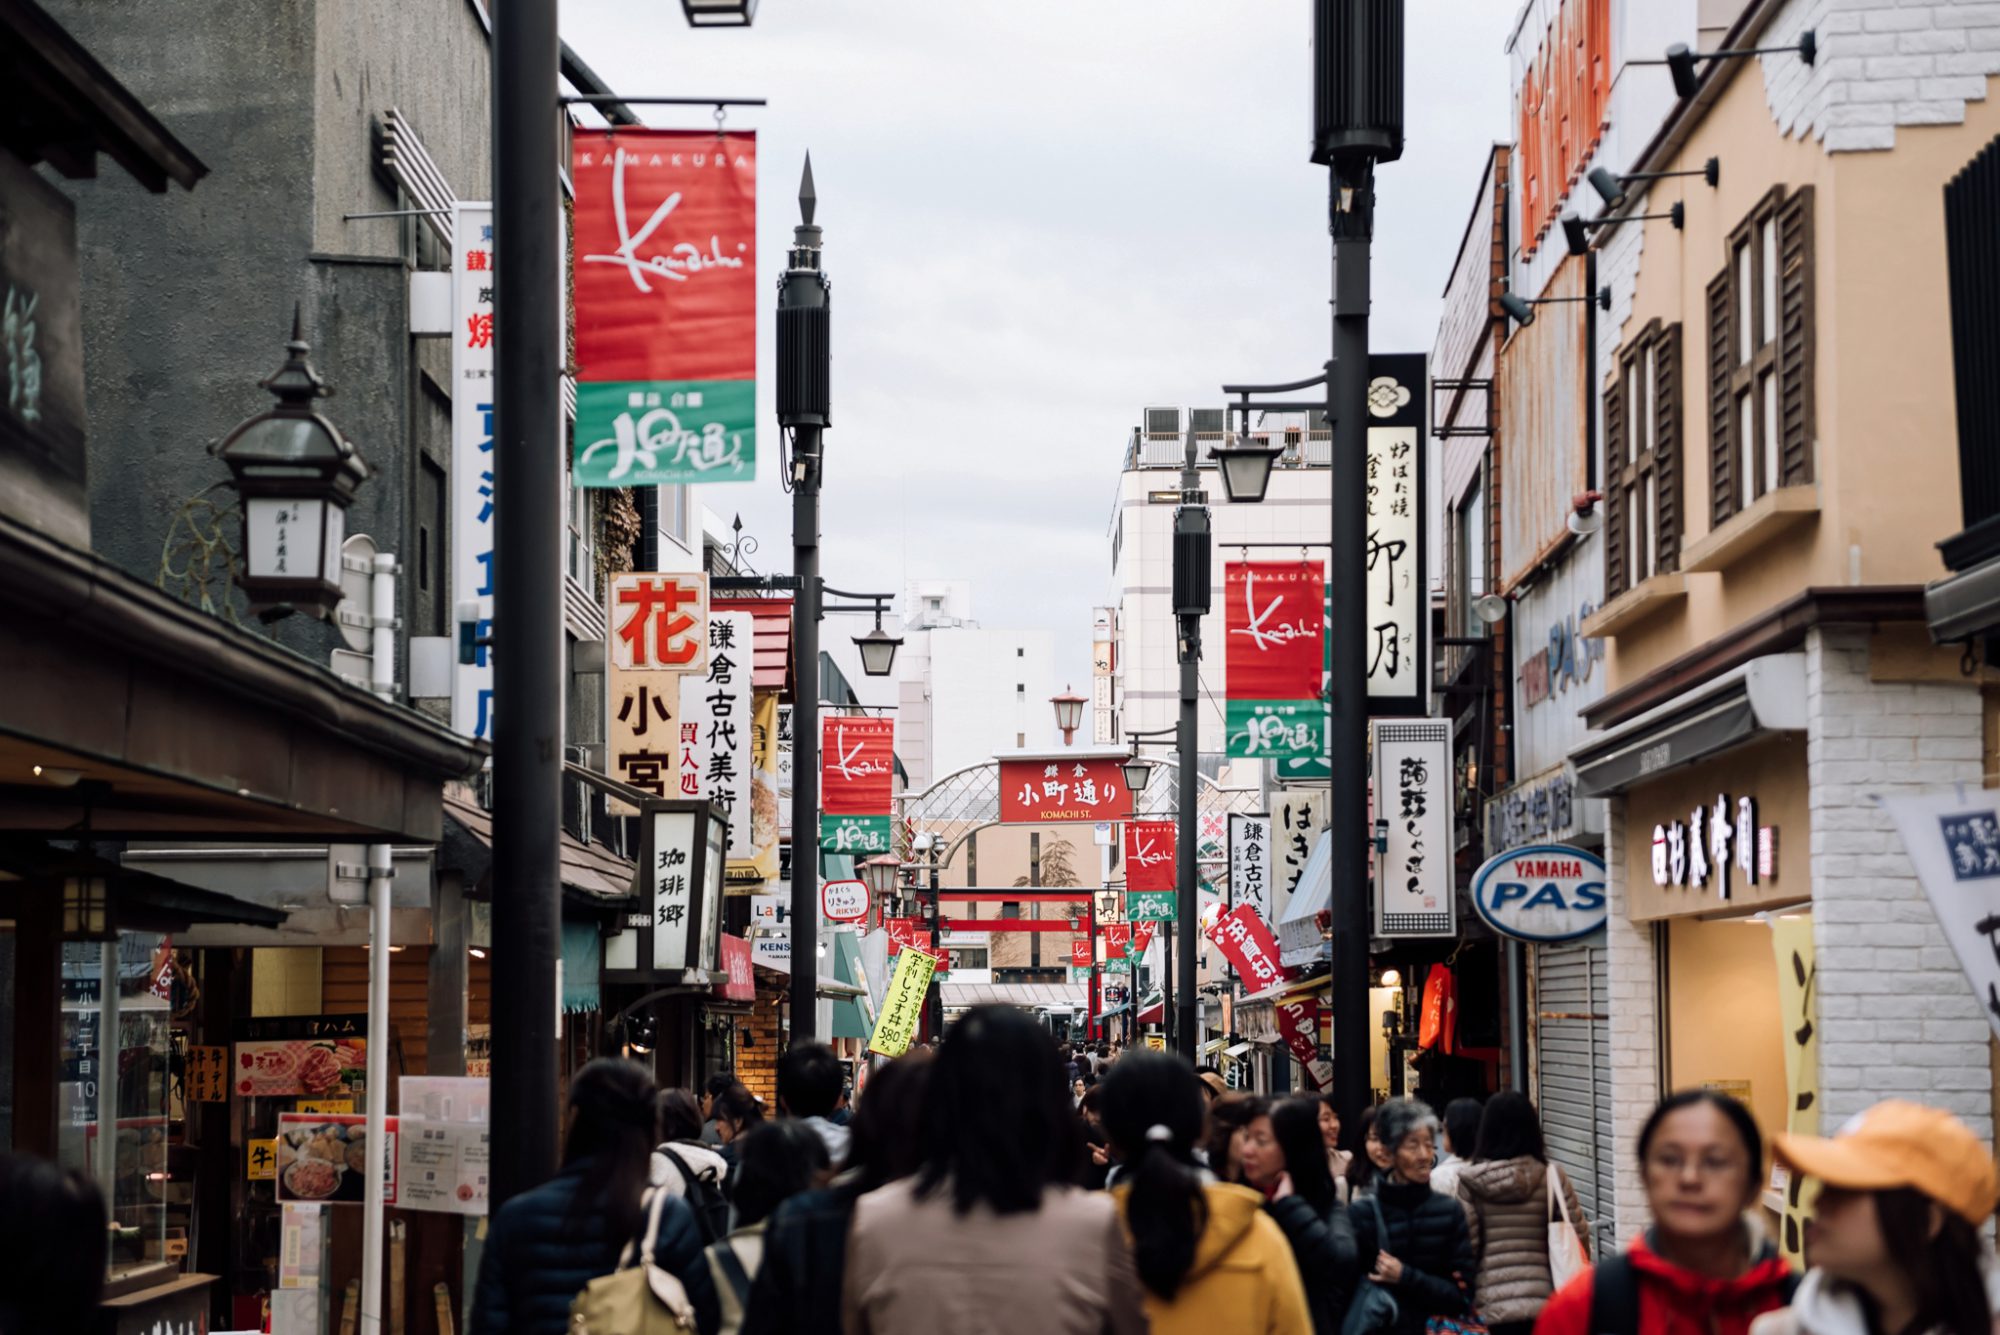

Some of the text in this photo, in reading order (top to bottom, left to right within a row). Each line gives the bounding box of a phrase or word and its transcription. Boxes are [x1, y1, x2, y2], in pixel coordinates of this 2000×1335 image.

[582, 153, 747, 168] KAMAKURA
[583, 147, 747, 293] Komachi
[1229, 573, 1320, 582] KAMAKURA
[617, 578, 699, 666] 花
[1230, 570, 1319, 651] Komachi
[826, 724, 888, 781] Komachi
[1043, 762, 1088, 779] 鎌倉
[1017, 778, 1116, 807] 小町通り
[1040, 809, 1092, 820] KOMACHI ST.
[1243, 821, 1264, 918] 鎌倉古代
[1514, 860, 1583, 878] YAMAHA
[658, 847, 686, 928] 珈琲郷
[1490, 881, 1606, 911] PAS
[836, 907, 861, 916] RIKYU
[760, 943, 791, 952] KENS
[78, 991, 93, 1075] 小町二丁目
[878, 1026, 900, 1043] 580
[74, 1081, 97, 1099] 10
